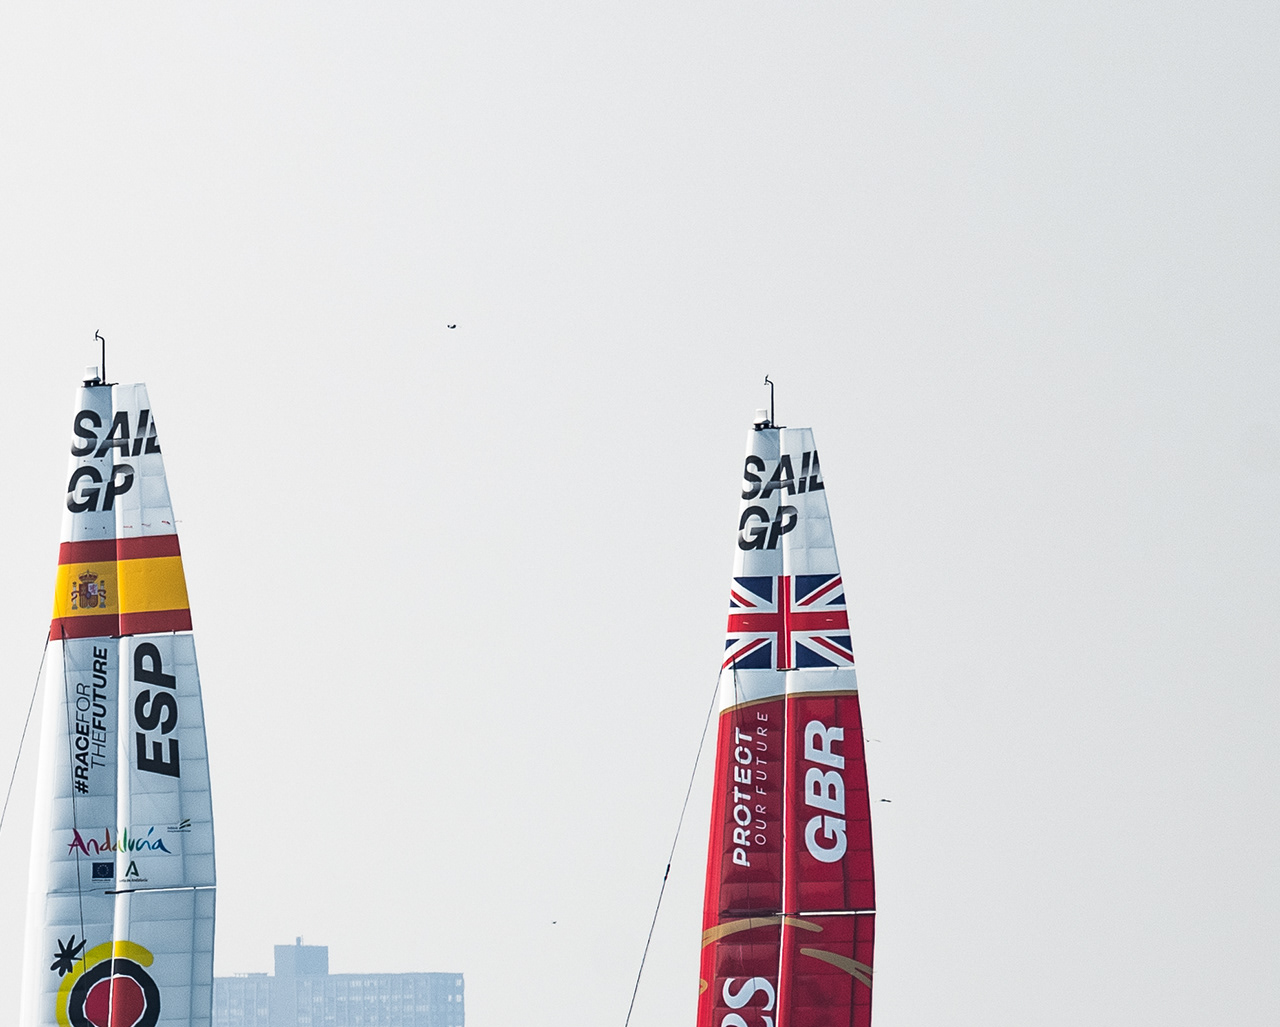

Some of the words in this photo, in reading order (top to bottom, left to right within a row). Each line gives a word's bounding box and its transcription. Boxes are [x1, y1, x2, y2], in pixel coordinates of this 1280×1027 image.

[70, 409, 162, 458] SAIL
[67, 464, 135, 514] GP
[741, 450, 825, 500] SAIL
[737, 504, 799, 551] GP
[76, 682, 90, 794] #RACEFOR
[91, 646, 107, 770] THEFUTURE
[134, 641, 180, 778] ESP
[755, 710, 769, 795] FUTURE
[732, 727, 753, 868] PROTECT
[803, 719, 848, 864] GBR
[67, 826, 171, 856] Andalucía
[754, 805, 767, 846] OUR
